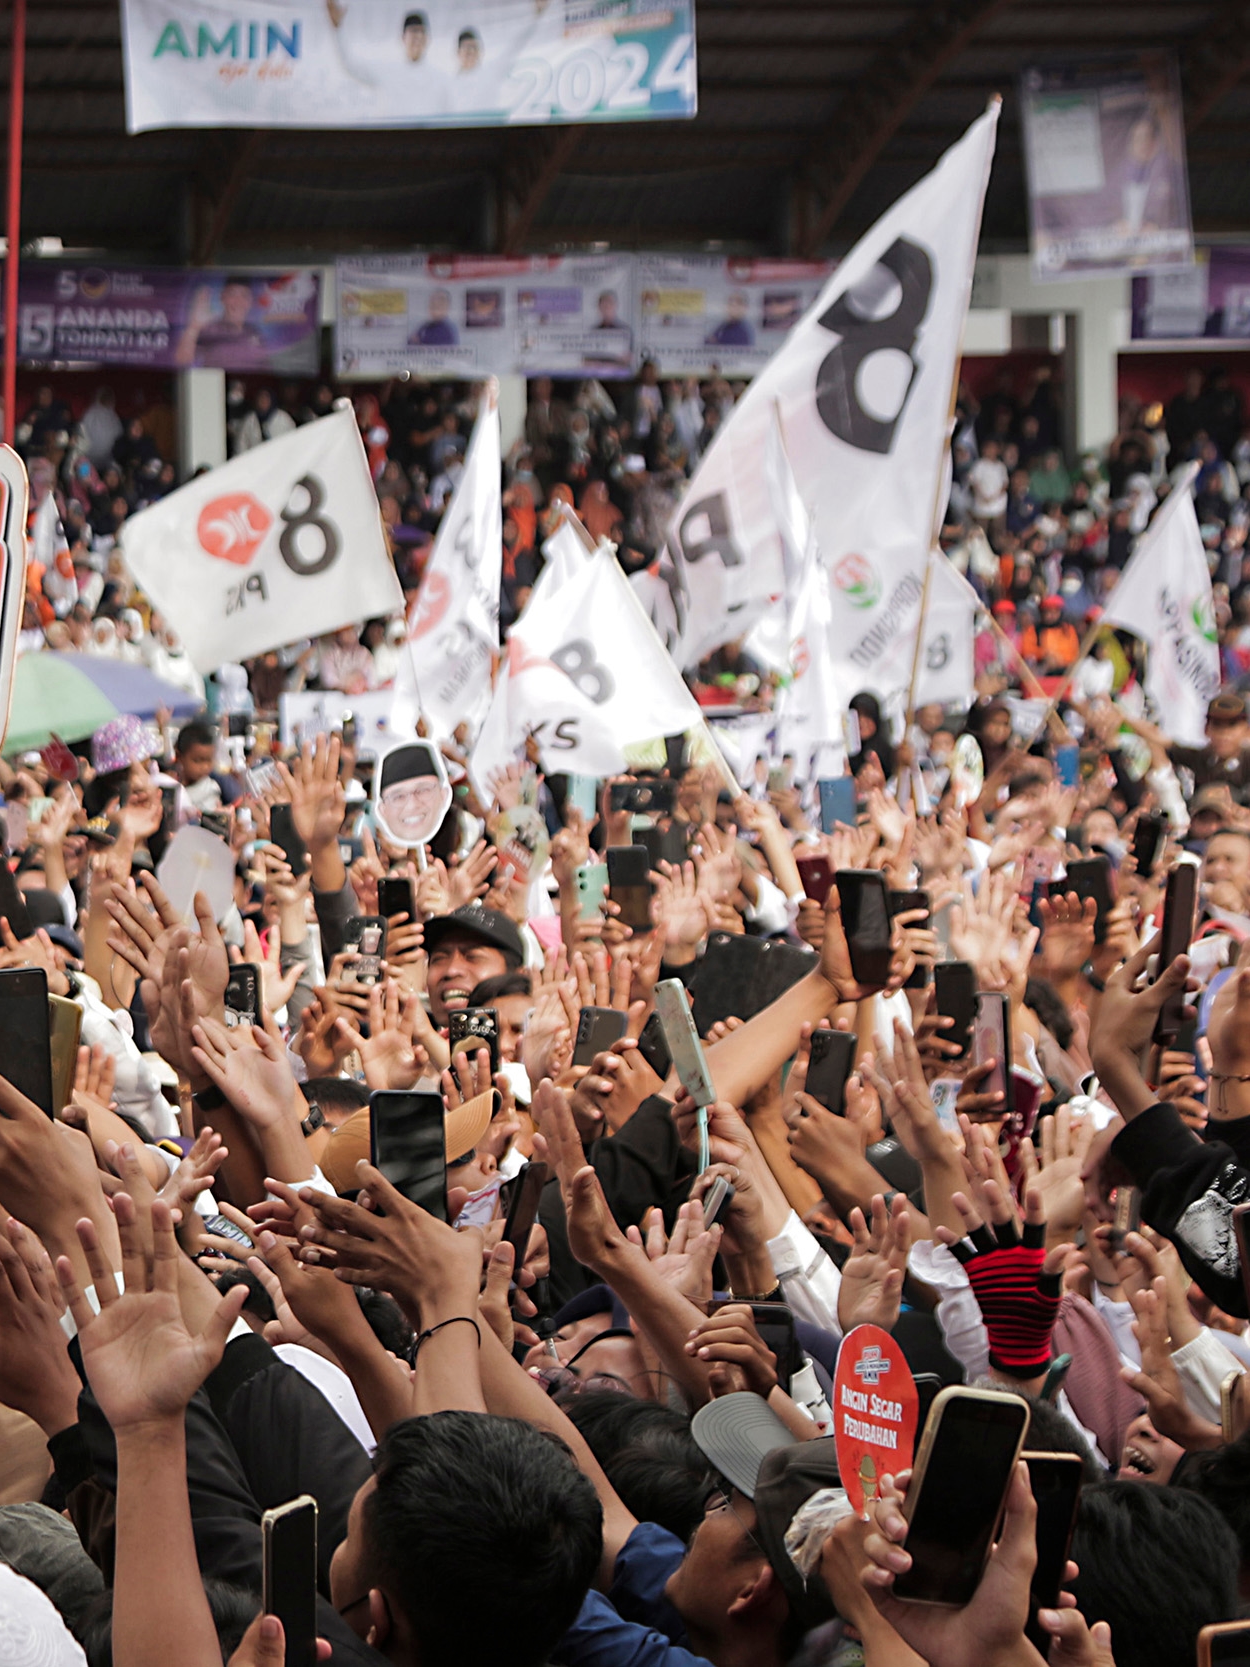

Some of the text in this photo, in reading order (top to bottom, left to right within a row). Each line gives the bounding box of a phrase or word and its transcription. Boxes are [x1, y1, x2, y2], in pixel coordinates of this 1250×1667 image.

[152, 20, 302, 59] AMIN
[509, 34, 695, 123] 2024
[58, 270, 77, 298] 5
[58, 307, 170, 329] ANANDA
[816, 233, 937, 457] 8
[279, 476, 342, 576] 8
[841, 1383, 903, 1422] ANGIN SEGAR
[843, 1412, 898, 1450] PERUBAHAN
